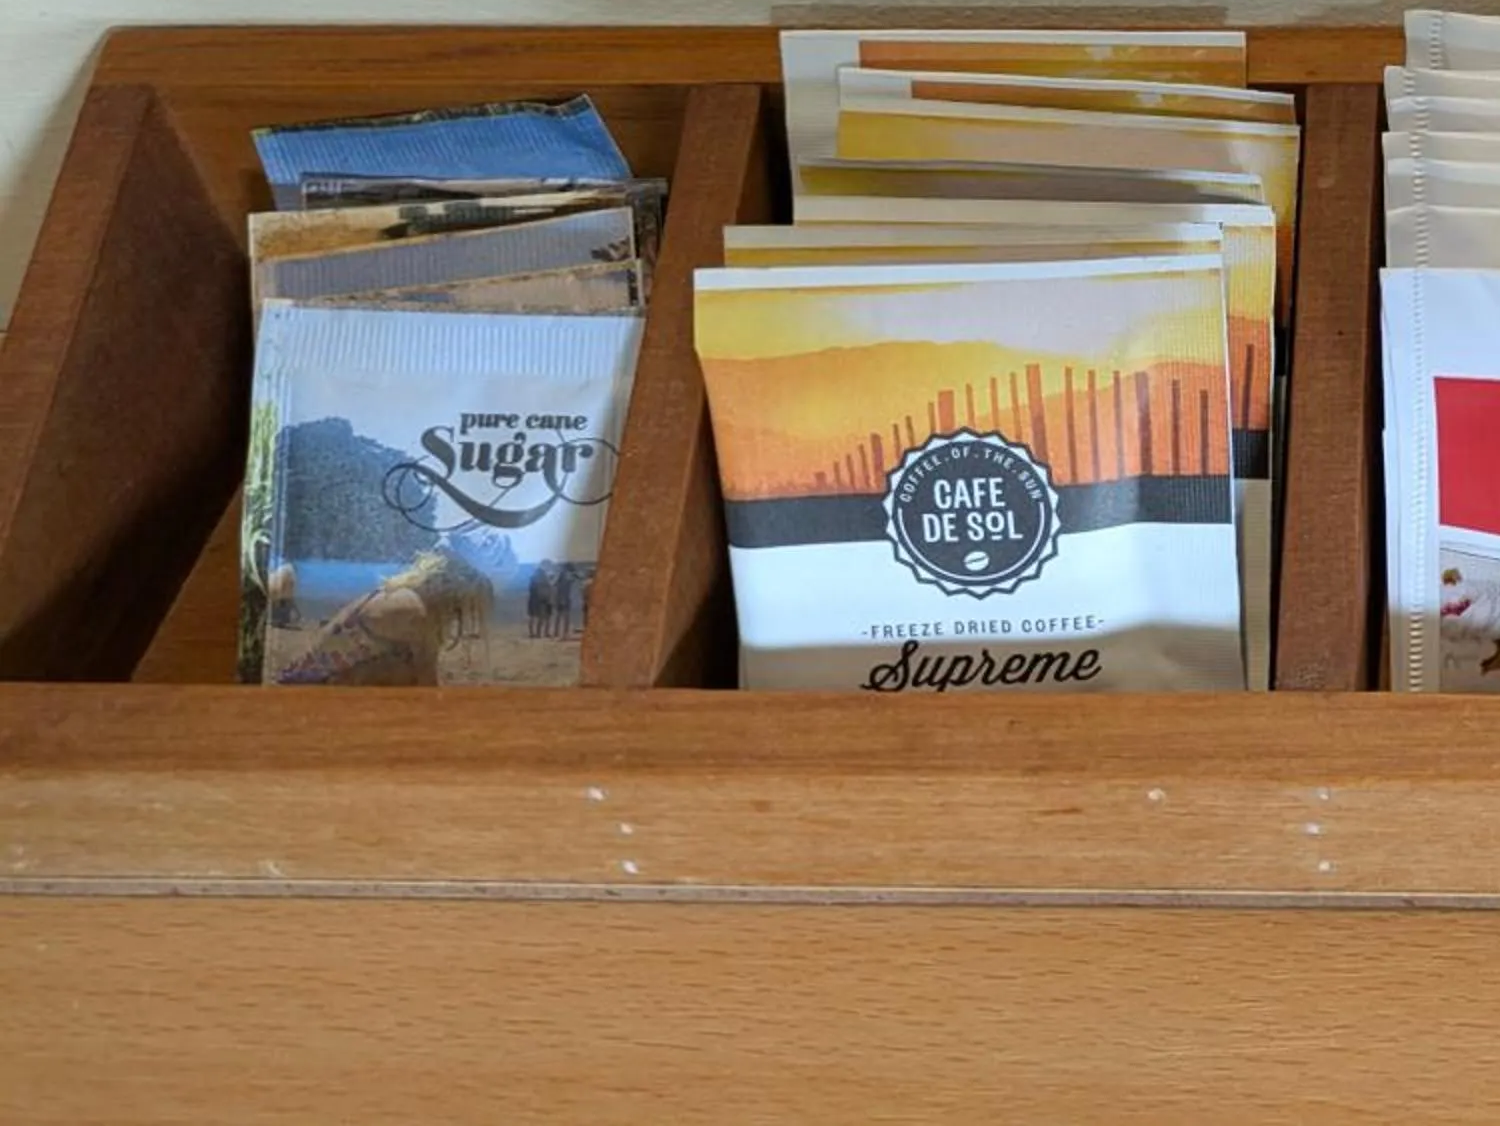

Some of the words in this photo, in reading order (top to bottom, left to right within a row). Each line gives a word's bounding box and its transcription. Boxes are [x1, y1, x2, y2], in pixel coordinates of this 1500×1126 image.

[458, 413, 520, 435] pure
[525, 413, 588, 430] cane
[899, 455, 942, 503] COFFEE
[984, 449, 1015, 471] THE
[1019, 471, 1043, 500] SUN
[933, 477, 1006, 510] CAFE
[922, 512, 959, 543] DE
[954, 620, 1012, 636] DRIED
[860, 639, 1103, 693] Supreme
